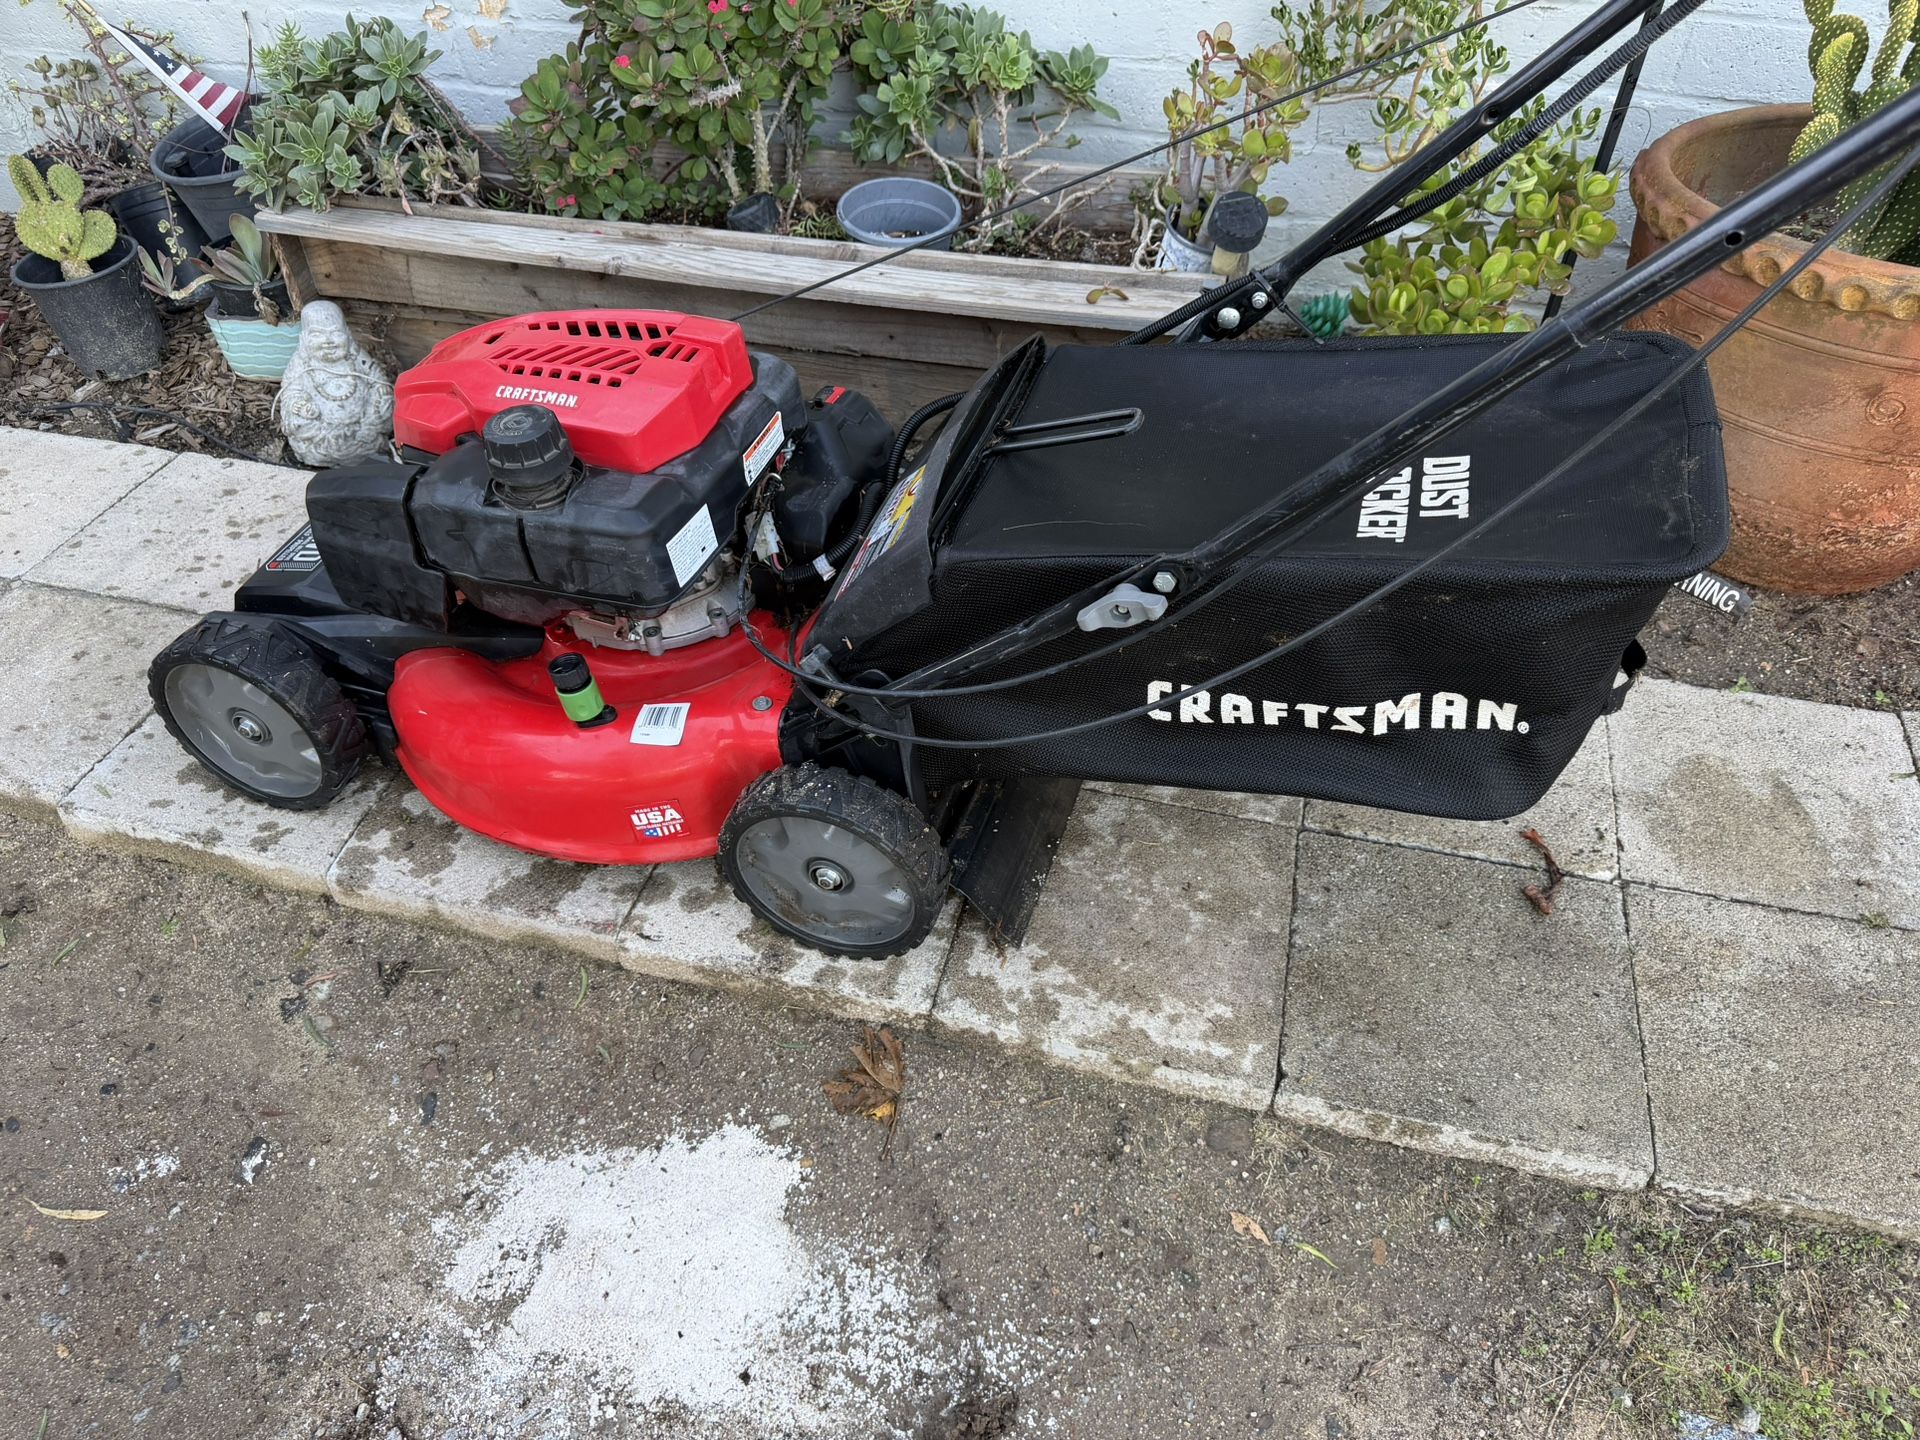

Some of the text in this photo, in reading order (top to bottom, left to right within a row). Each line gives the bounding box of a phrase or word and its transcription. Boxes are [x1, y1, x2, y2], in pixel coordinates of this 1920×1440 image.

[495, 385, 579, 408] CRAFTSMAN
[1419, 455, 1471, 519] DUST
[630, 808, 682, 826] USA
